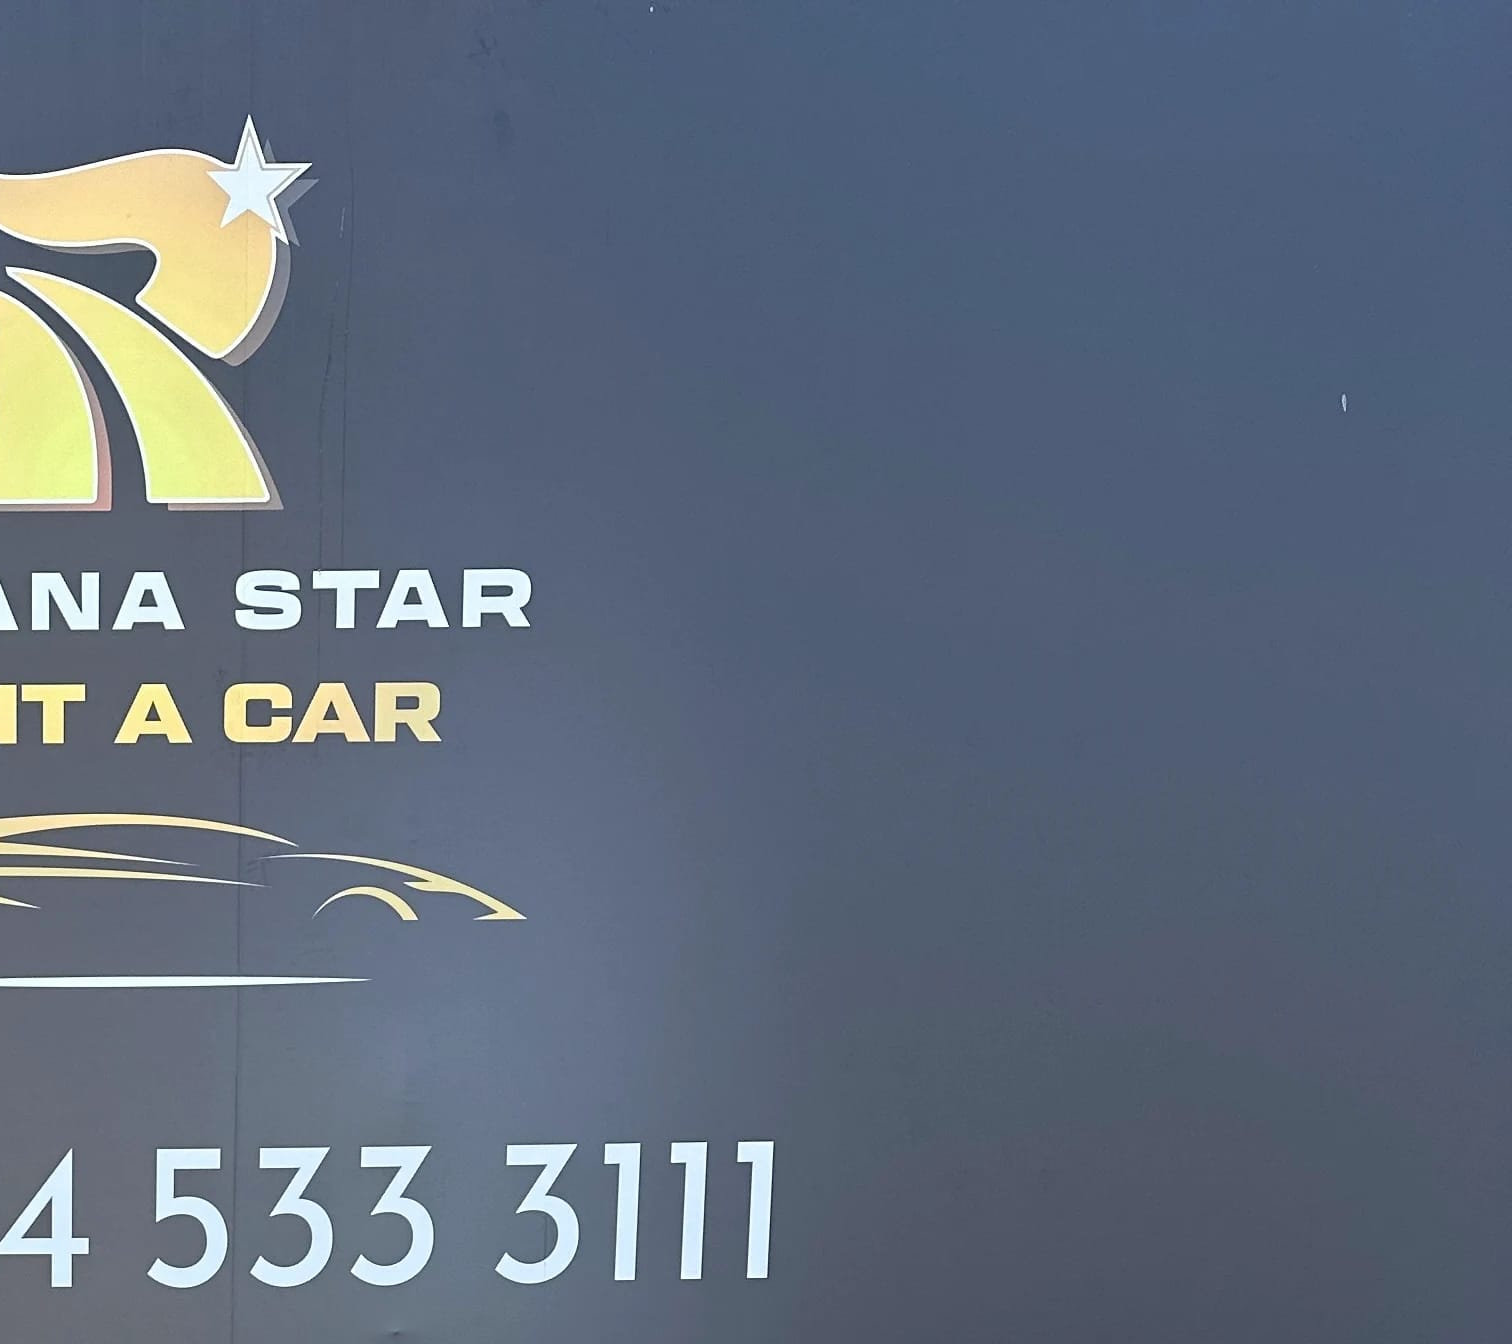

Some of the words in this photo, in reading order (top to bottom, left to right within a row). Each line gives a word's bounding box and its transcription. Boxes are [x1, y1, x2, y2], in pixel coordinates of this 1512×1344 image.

[234, 568, 532, 631] STAR
[113, 683, 193, 744] A
[223, 682, 442, 743] CAR
[147, 1145, 434, 1289] 533
[494, 1141, 774, 1284] 3111
